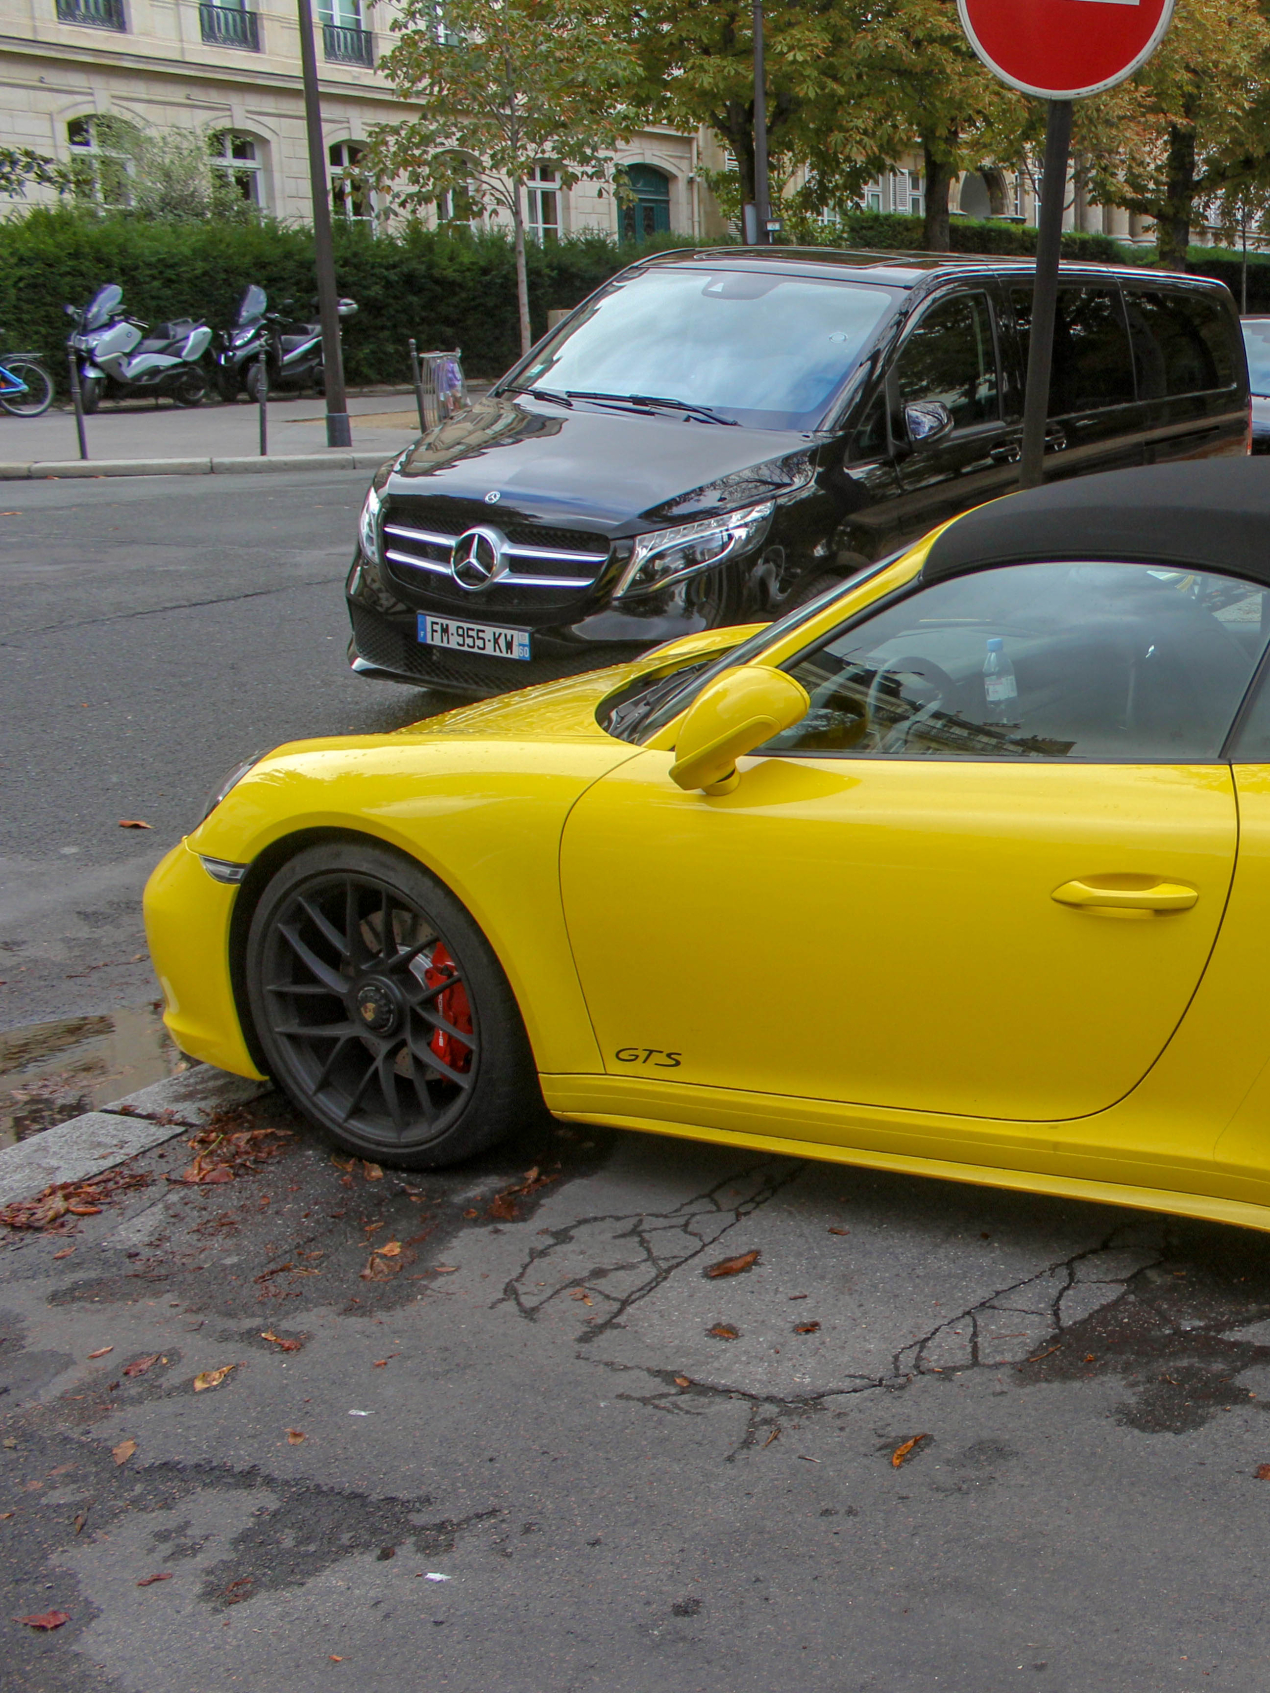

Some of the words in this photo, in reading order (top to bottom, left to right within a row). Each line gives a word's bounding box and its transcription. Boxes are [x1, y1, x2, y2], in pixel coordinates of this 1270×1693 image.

[430, 620, 514, 655] FM-955-KW
[518, 645, 529, 658] 60
[615, 1047, 682, 1068] GTS
